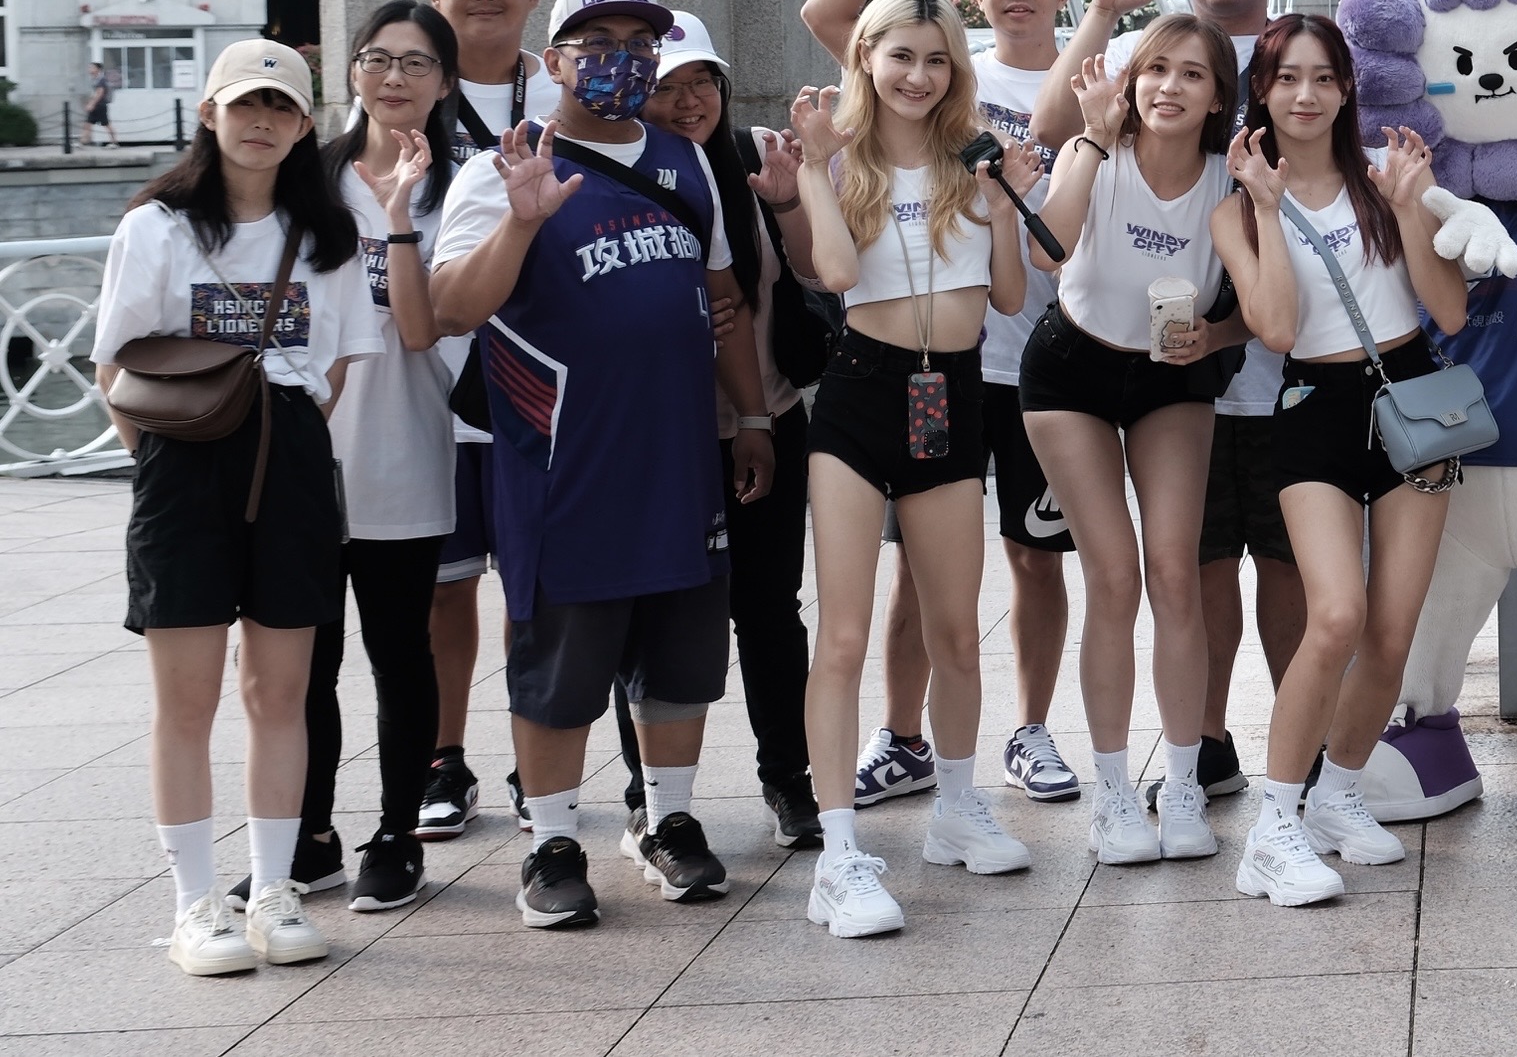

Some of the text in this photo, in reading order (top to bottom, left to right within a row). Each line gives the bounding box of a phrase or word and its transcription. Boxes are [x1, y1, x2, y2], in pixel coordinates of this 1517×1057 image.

[516, 85, 524, 103] EOS
[992, 119, 1031, 140] HSINC
[594, 211, 674, 235] HSINCH
[1126, 223, 1191, 250] WINDY
[1132, 237, 1182, 257] CITY
[213, 299, 289, 314] HSINCU
[206, 317, 296, 334] LIONERS
[1277, 822, 1293, 832] FILA
[1253, 849, 1287, 876] FILA
